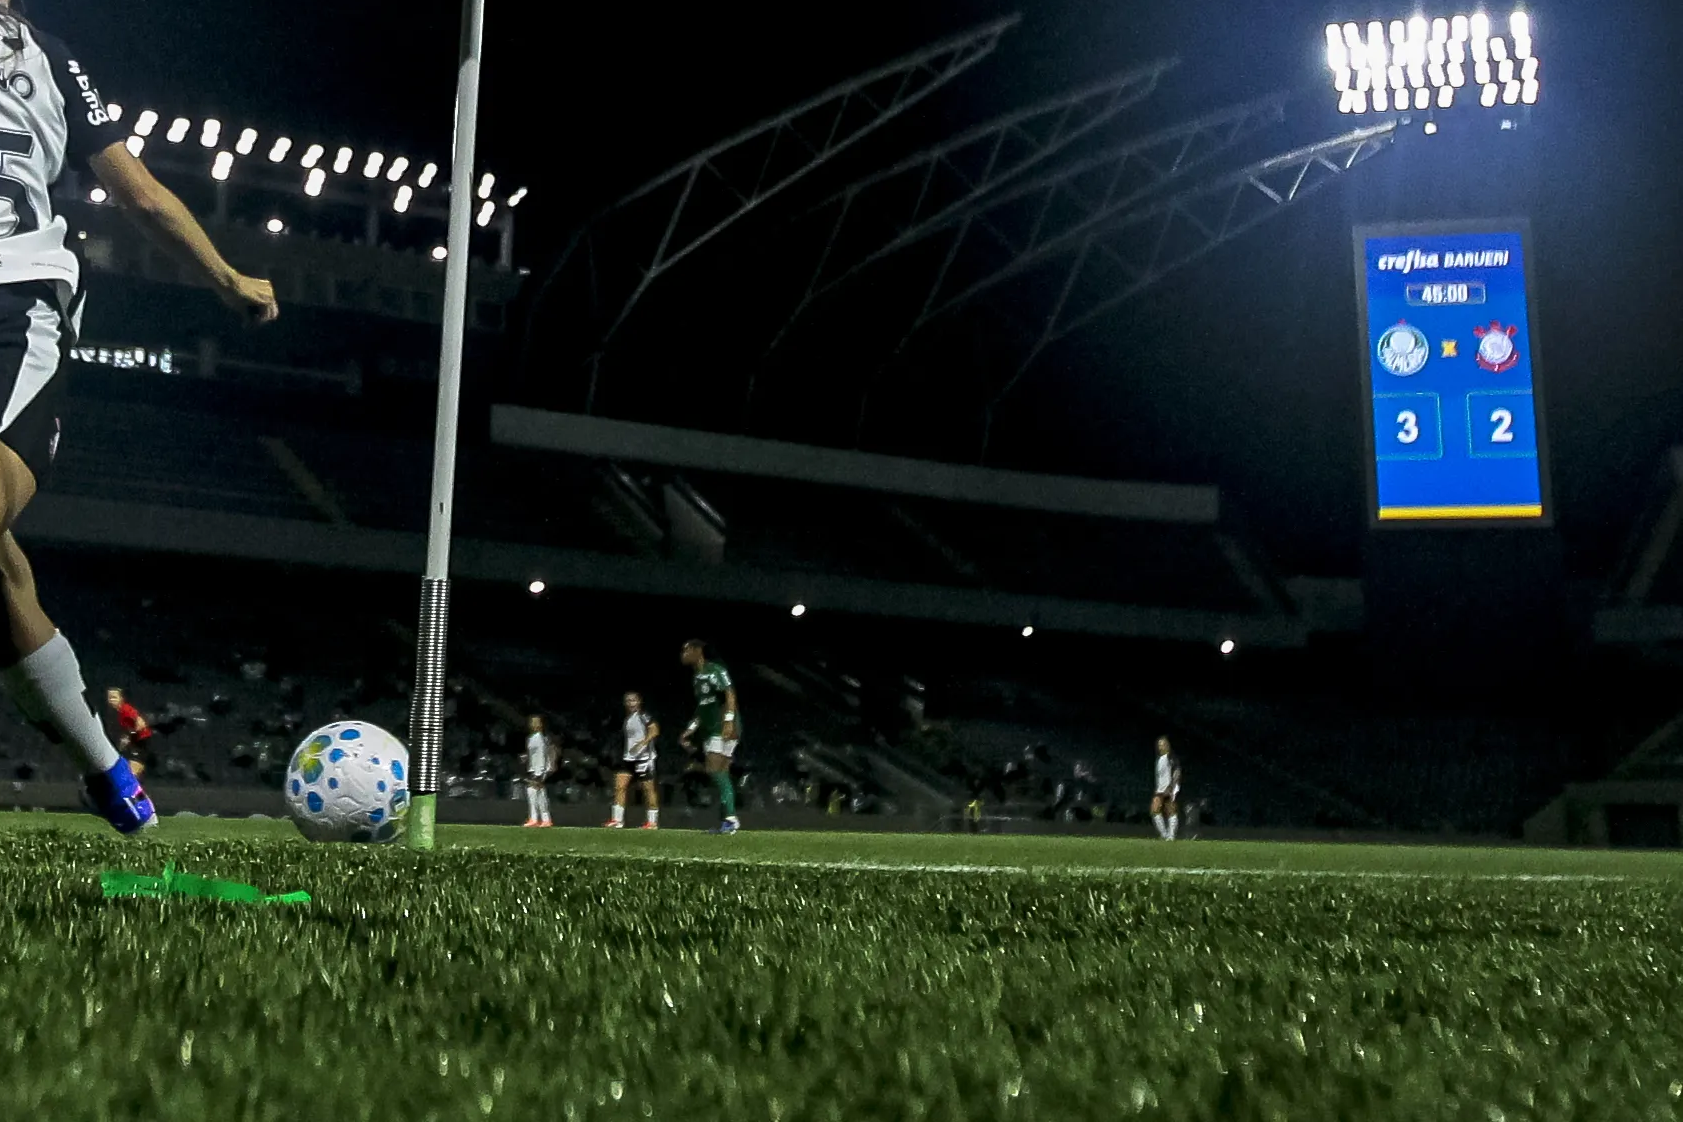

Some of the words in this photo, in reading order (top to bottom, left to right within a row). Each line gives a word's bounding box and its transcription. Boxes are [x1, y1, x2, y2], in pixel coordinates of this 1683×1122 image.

[76, 75, 110, 126] bmg
[1443, 249, 1509, 269] BARUERI
[1397, 409, 1419, 444] 3
[1490, 407, 1514, 442] 2
